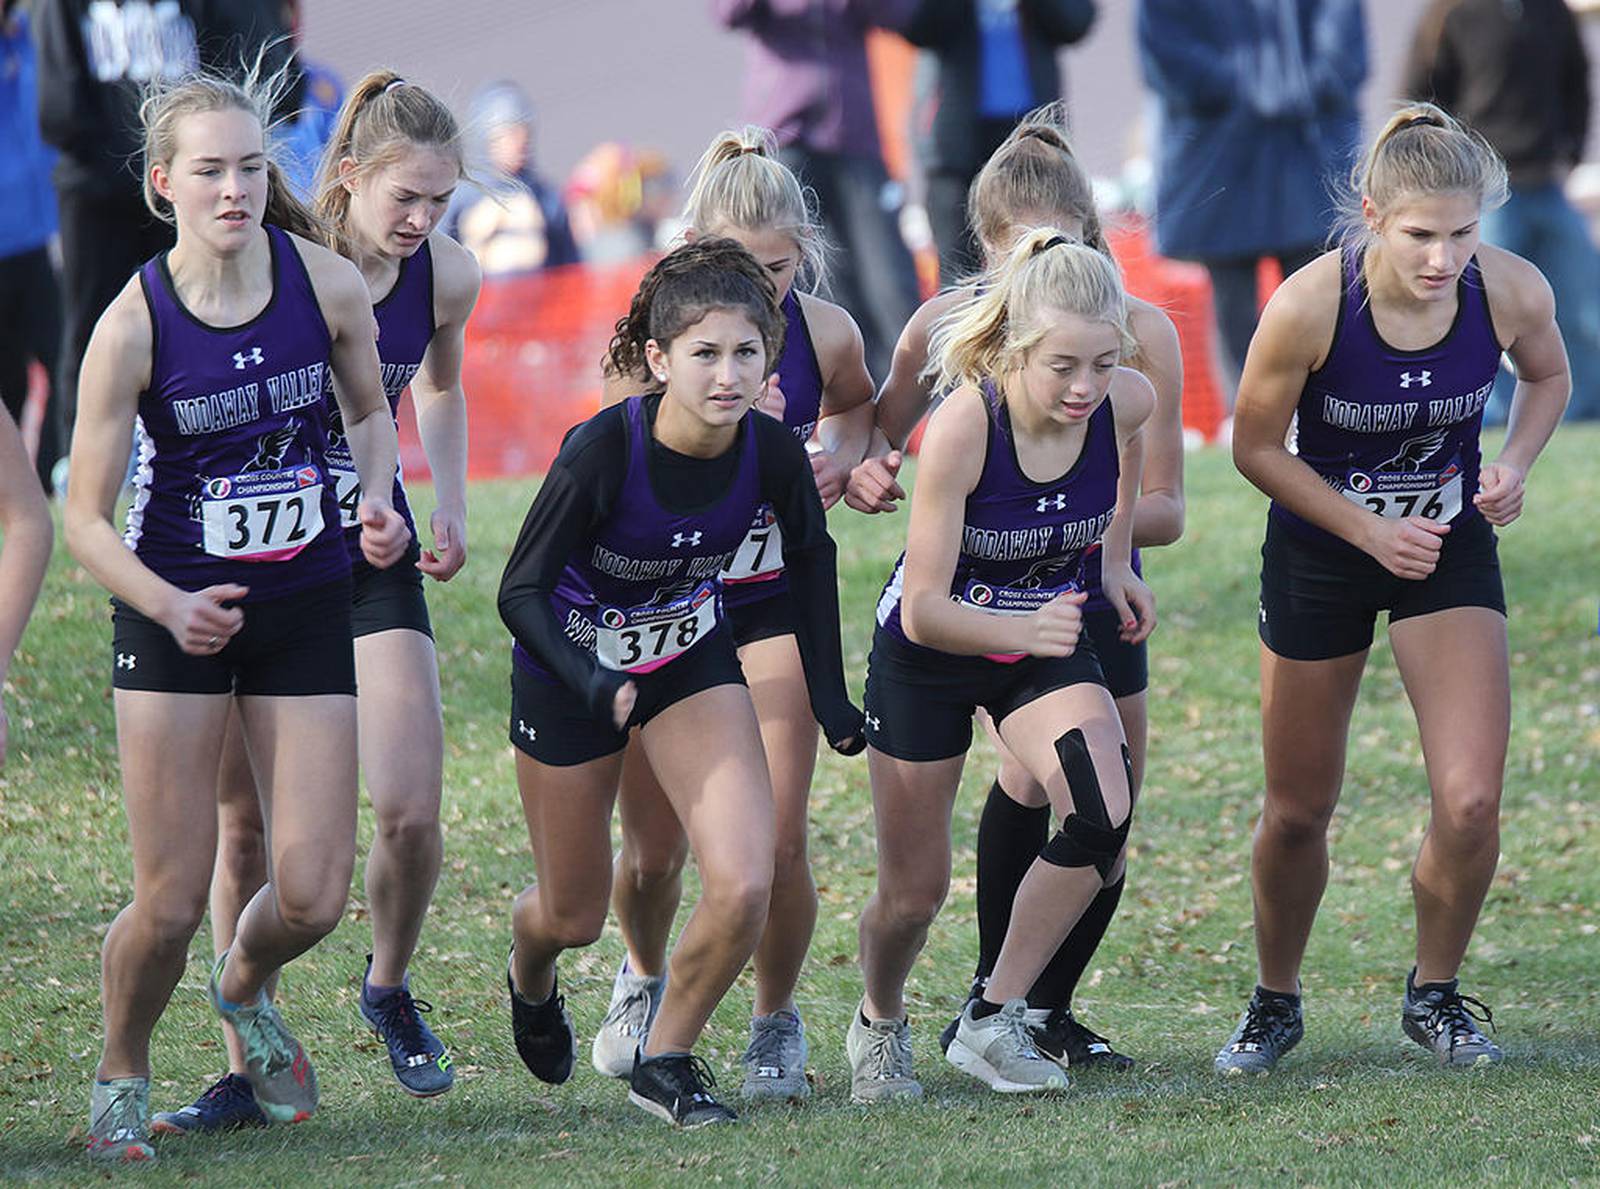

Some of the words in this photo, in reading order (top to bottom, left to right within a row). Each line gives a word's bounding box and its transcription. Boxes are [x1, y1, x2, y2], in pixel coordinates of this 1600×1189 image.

[173, 383, 259, 435] NODAWAY
[266, 362, 324, 413] VALLEY
[1323, 395, 1418, 433] NODAWAY
[1377, 474, 1400, 482] CROSS
[1402, 473, 1438, 482] COUNTRY
[1377, 481, 1437, 490] CHAMPIONSHIPS
[228, 496, 307, 550] 372
[961, 524, 1054, 562] NODAWAY
[592, 544, 684, 581] NODAWAY
[998, 590, 1022, 599] CROSS
[619, 615, 699, 665] 378
